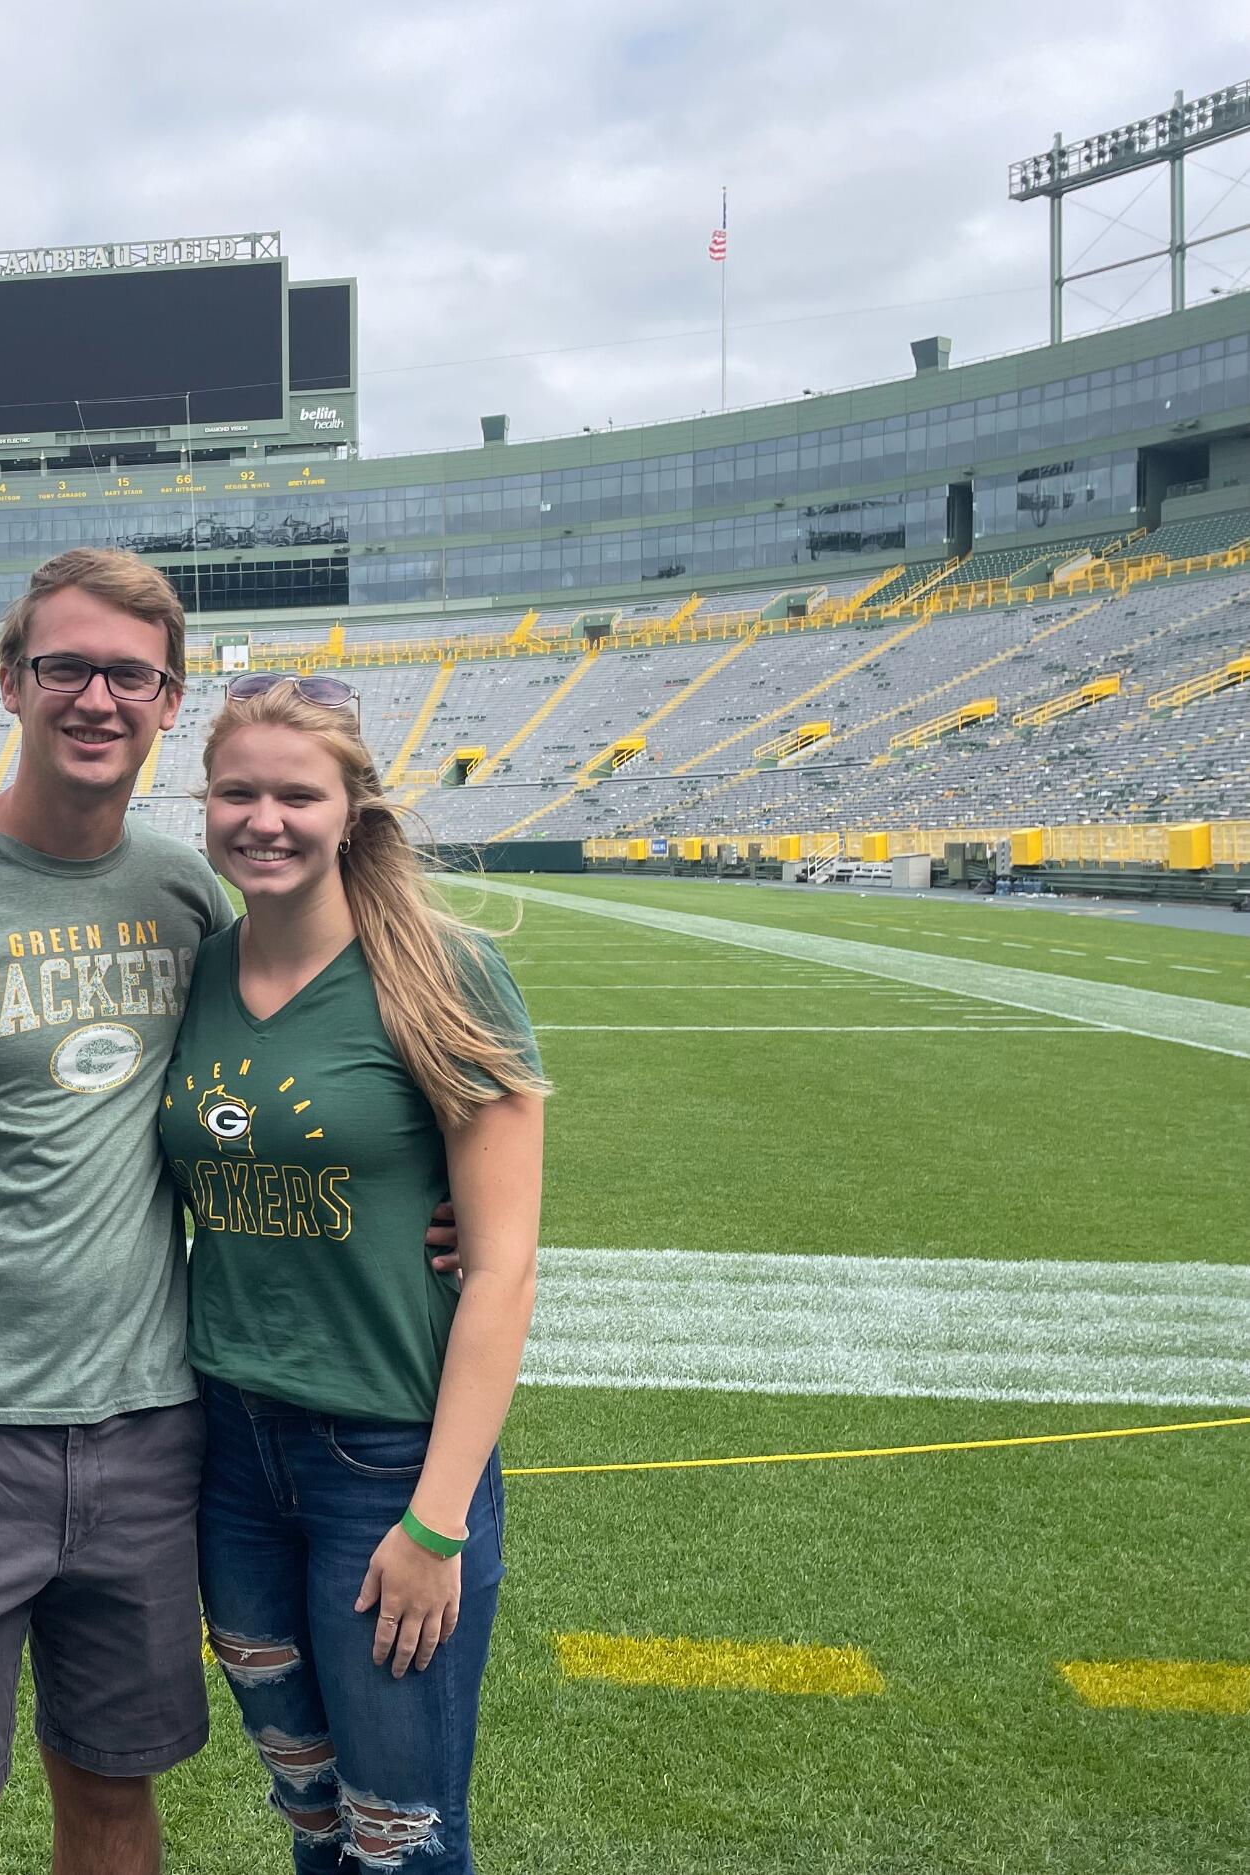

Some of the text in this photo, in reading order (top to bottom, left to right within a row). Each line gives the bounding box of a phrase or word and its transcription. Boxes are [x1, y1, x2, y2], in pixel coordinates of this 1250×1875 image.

[146, 238, 238, 265] FIELD
[300, 406, 337, 420] bellin
[314, 418, 344, 430] health
[240, 471, 255, 481] 92
[302, 467, 311, 477] 4
[58, 481, 66, 490] 3
[117, 478, 130, 487] 15
[176, 474, 191, 484] 66
[8, 920, 158, 957] GREEN BAY
[159, 1058, 252, 1135] REEN
[207, 1104, 249, 1137] G
[170, 1159, 352, 1241] CKERS
